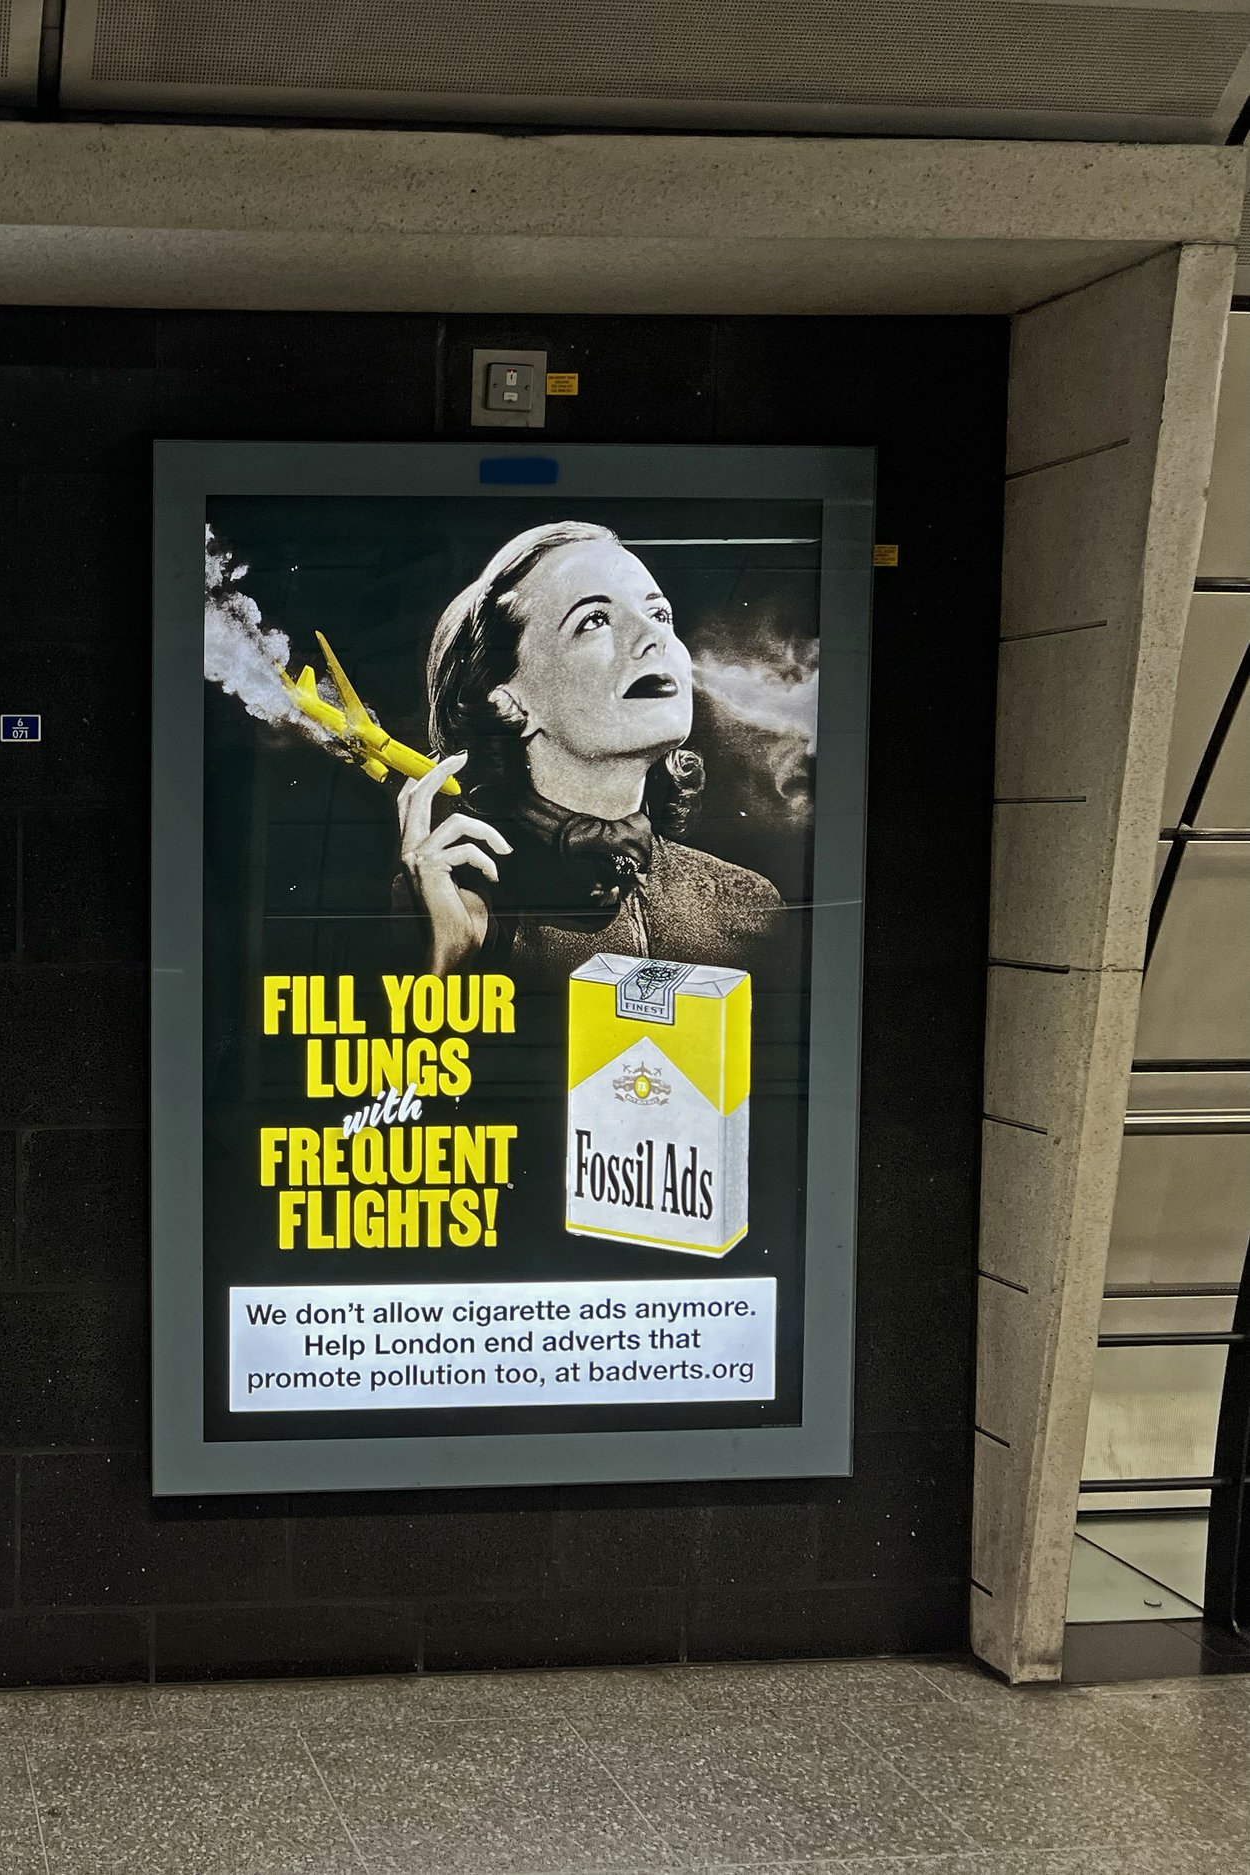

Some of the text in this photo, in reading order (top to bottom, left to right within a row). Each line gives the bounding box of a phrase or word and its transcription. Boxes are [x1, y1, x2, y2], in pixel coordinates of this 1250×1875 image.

[12, 729, 28, 739] 071
[17, 717, 24, 727] 6
[263, 974, 516, 1035] FILL YOUR
[625, 1002, 666, 1015] FINEST
[307, 1037, 472, 1098] LUNGS
[342, 1082, 423, 1138] with
[260, 1125, 518, 1187] FREQUENT
[574, 1128, 714, 1221] Fossil Ads
[279, 1188, 499, 1250] FLIGHTS!
[245, 1298, 756, 1327] We don’t allow cigarette ads anymore.
[305, 1328, 701, 1361] Help London end adverts that
[248, 1359, 754, 1394] promote pollution too, at badverts.org
